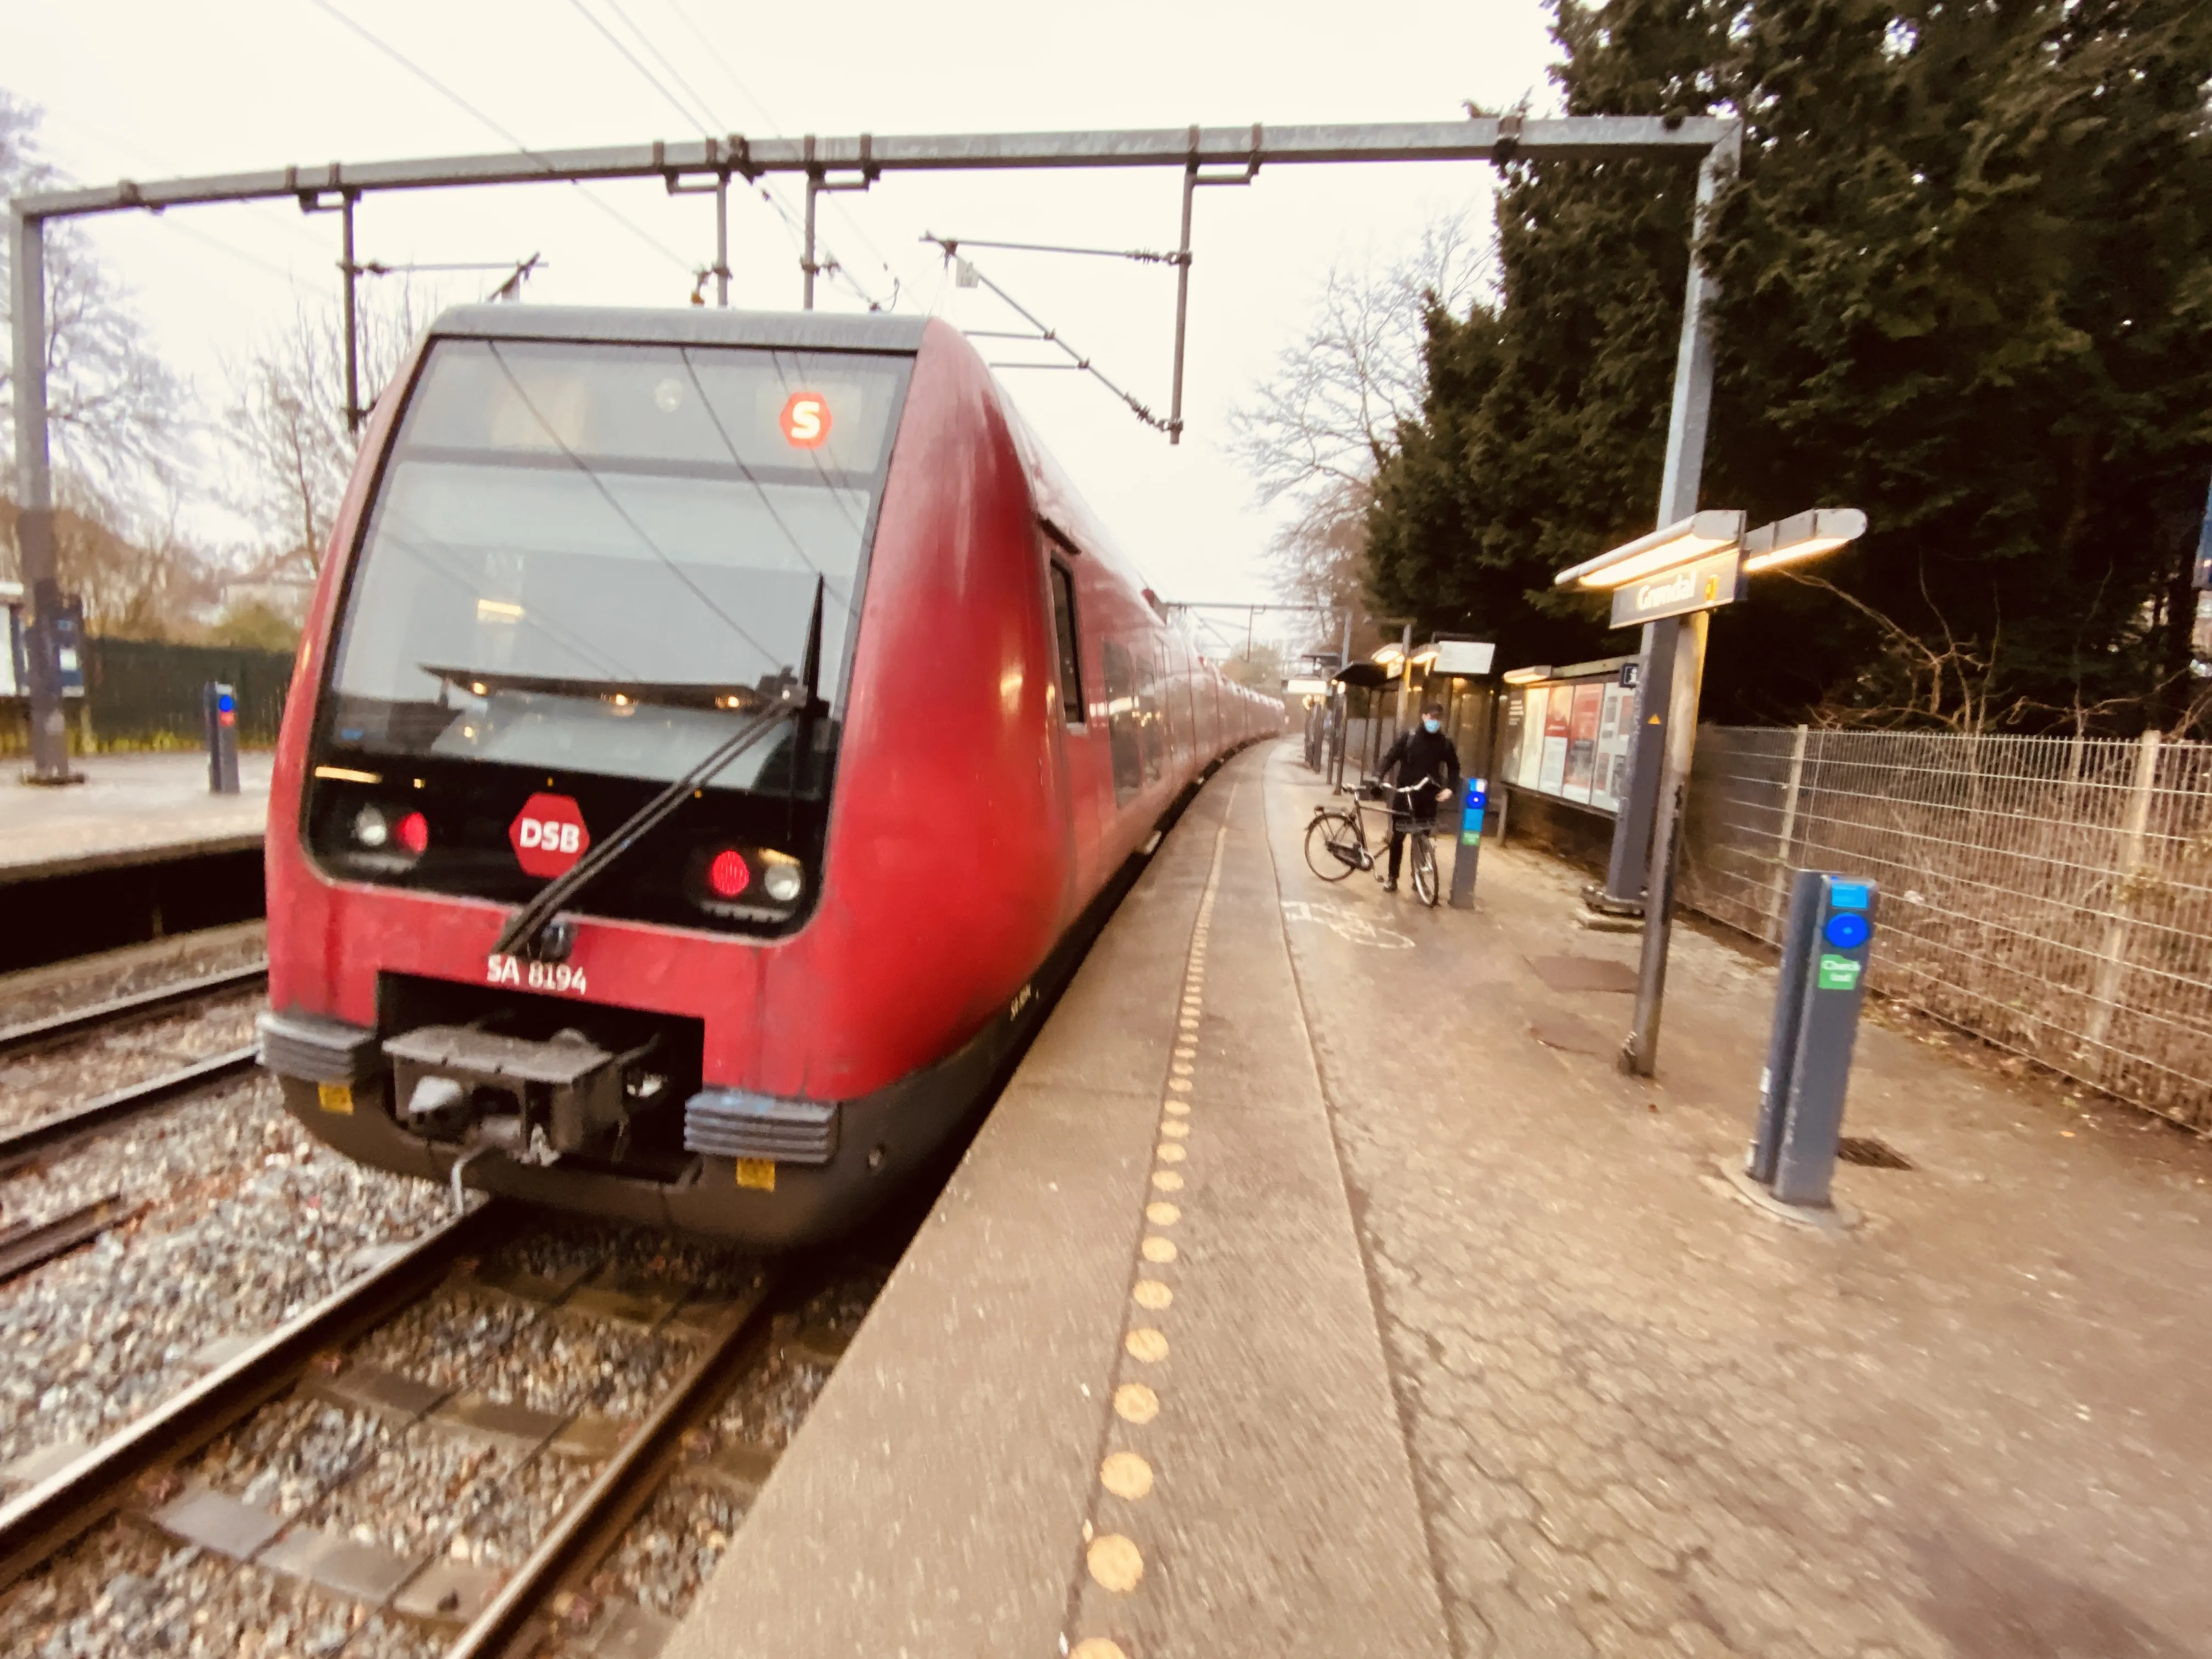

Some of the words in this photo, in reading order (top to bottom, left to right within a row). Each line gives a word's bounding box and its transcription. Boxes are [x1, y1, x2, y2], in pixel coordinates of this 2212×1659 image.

[791, 400, 820, 439] S
[520, 817, 580, 854] DSB
[487, 953, 520, 985] SA
[528, 961, 586, 995] 8194
